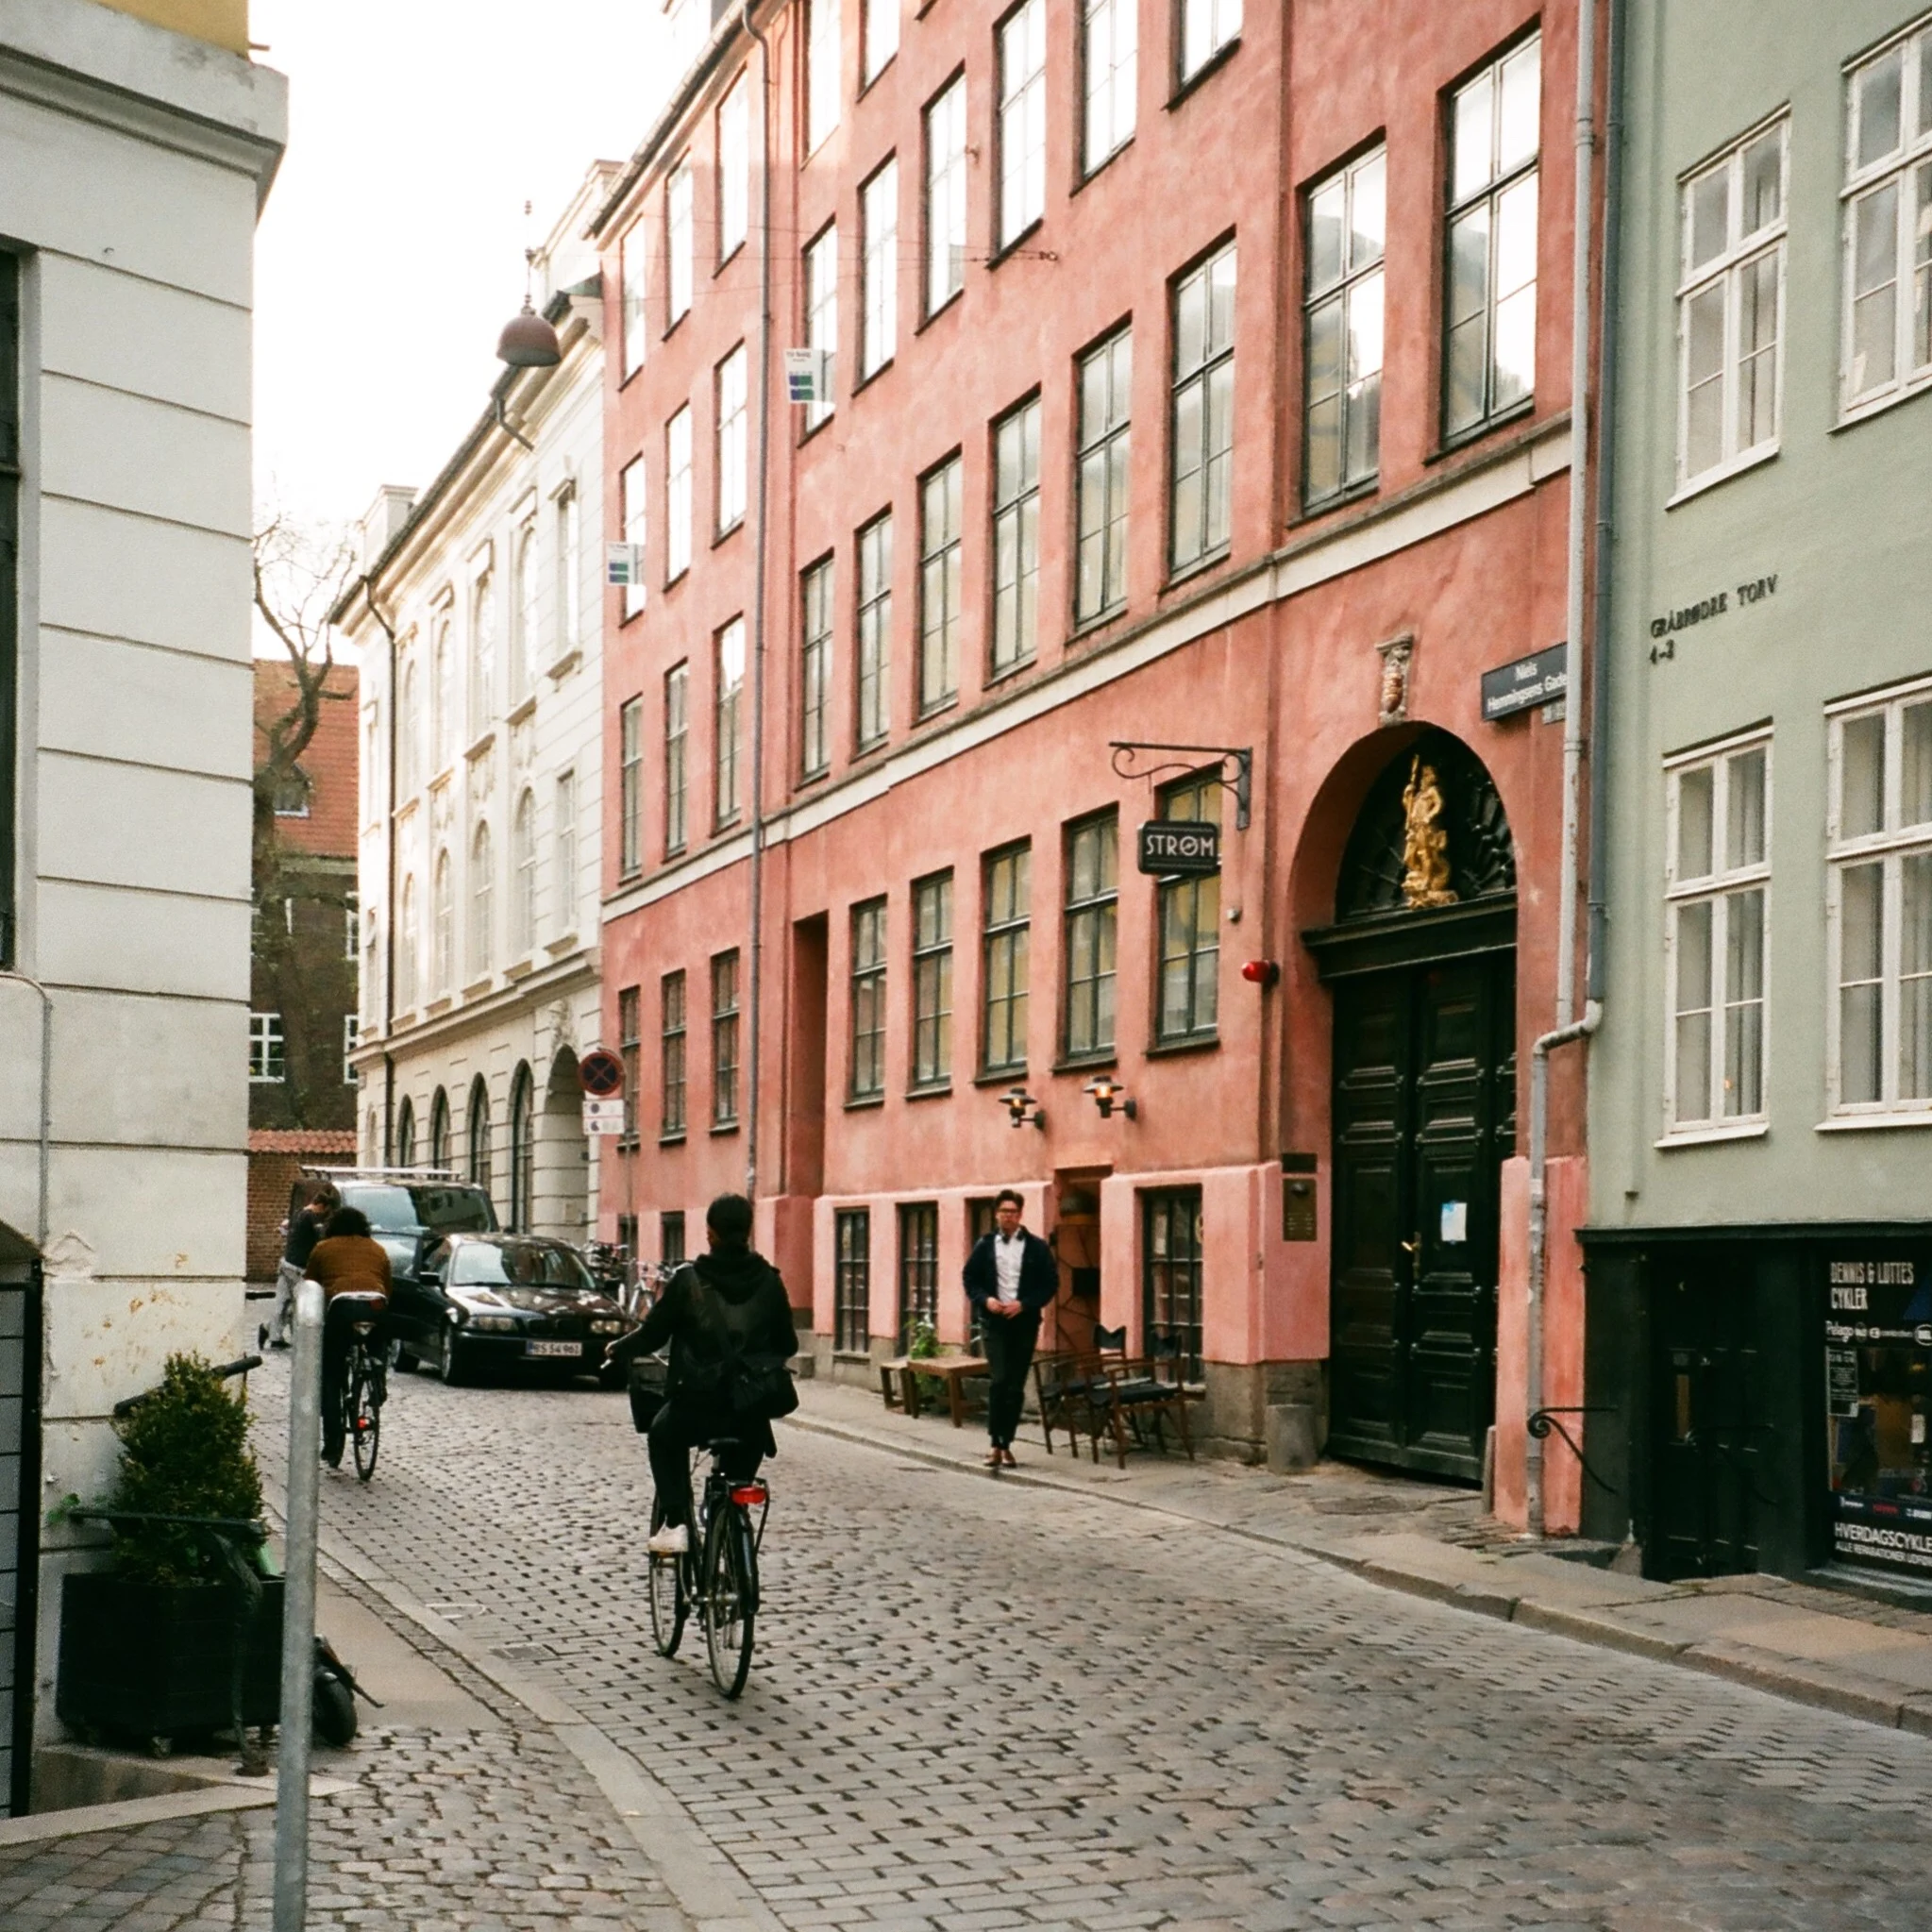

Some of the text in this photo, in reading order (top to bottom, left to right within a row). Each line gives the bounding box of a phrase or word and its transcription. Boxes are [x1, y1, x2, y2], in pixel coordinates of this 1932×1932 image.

[1737, 574, 1778, 606] TORV
[1146, 834, 1215, 857] STRØM
[1830, 1287, 1868, 1310] CYKLER
